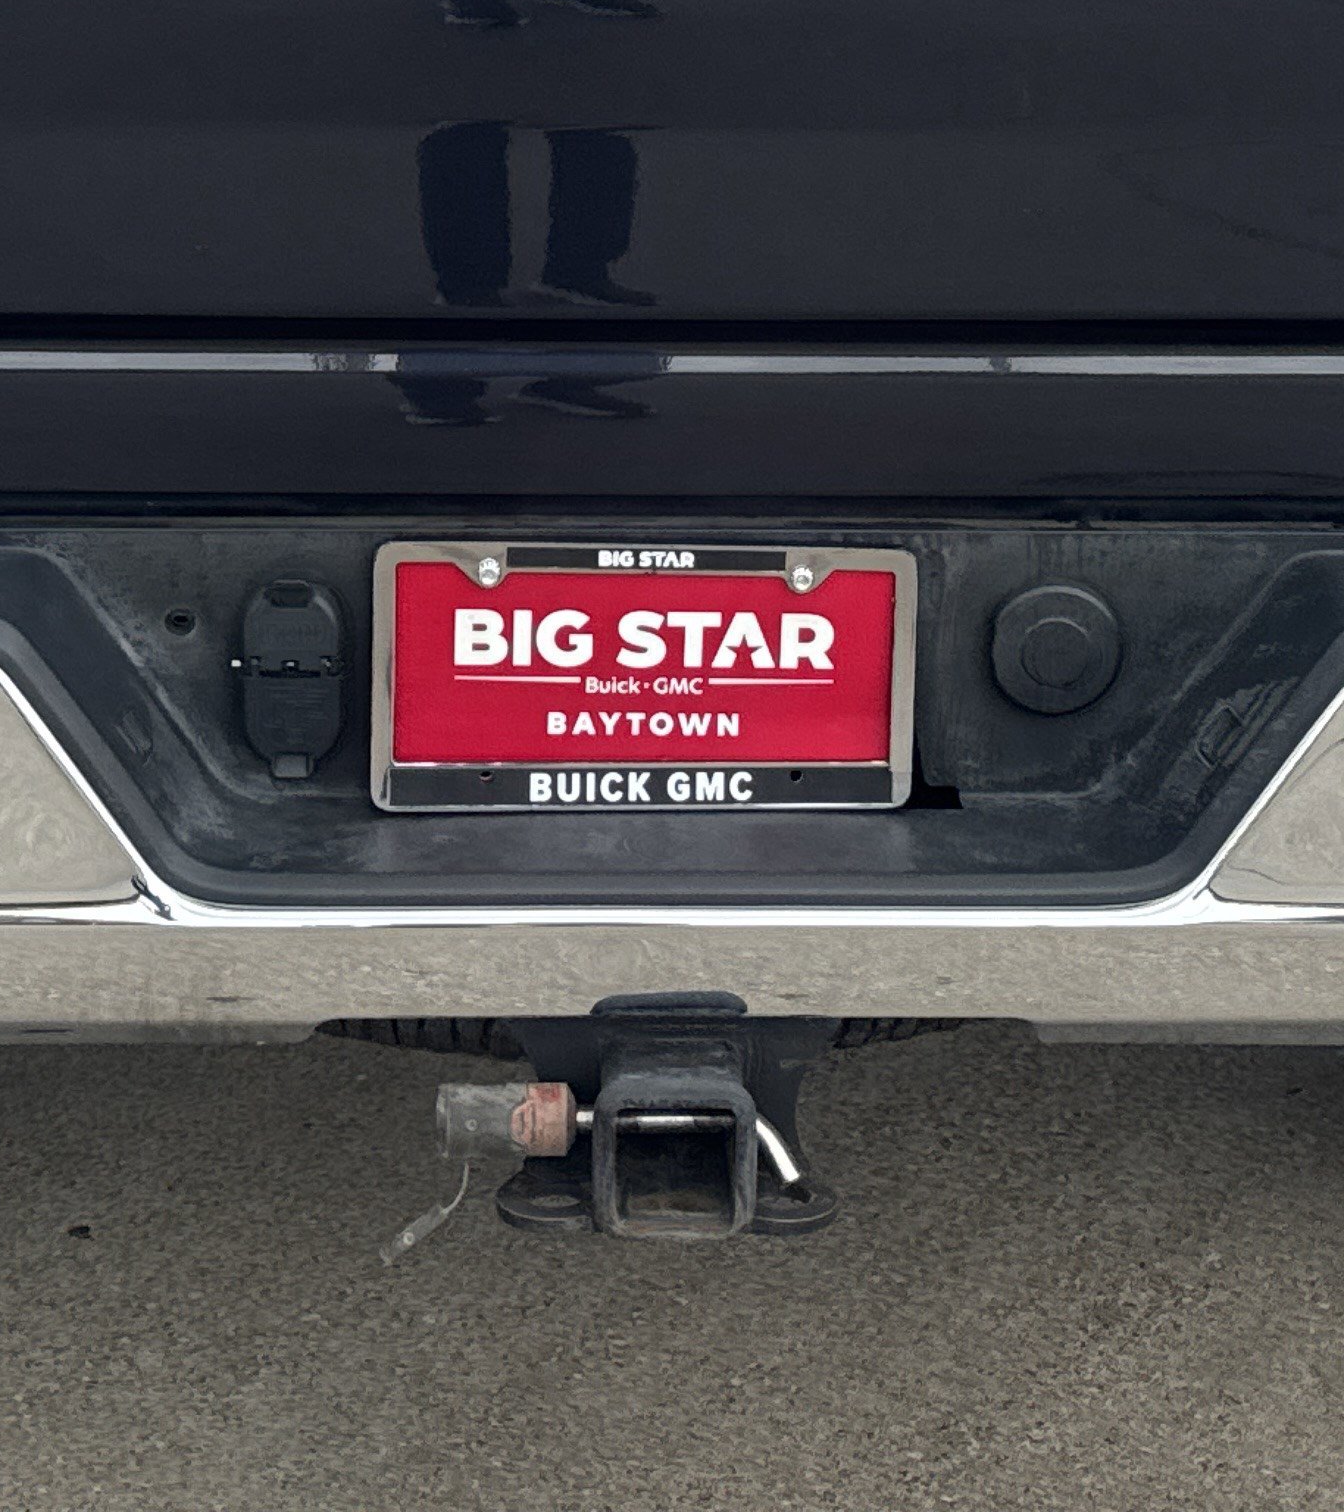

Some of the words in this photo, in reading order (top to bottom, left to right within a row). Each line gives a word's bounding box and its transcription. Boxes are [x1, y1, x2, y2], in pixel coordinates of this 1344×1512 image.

[597, 550, 635, 569] BIG
[637, 551, 696, 570] STAR
[453, 608, 594, 667] BIG
[615, 610, 835, 670] STAR
[584, 676, 641, 695] Buick
[652, 676, 704, 695] GMC
[546, 711, 740, 737] BAYTOWN
[529, 771, 651, 803] BUICK
[667, 771, 754, 803] GMC
